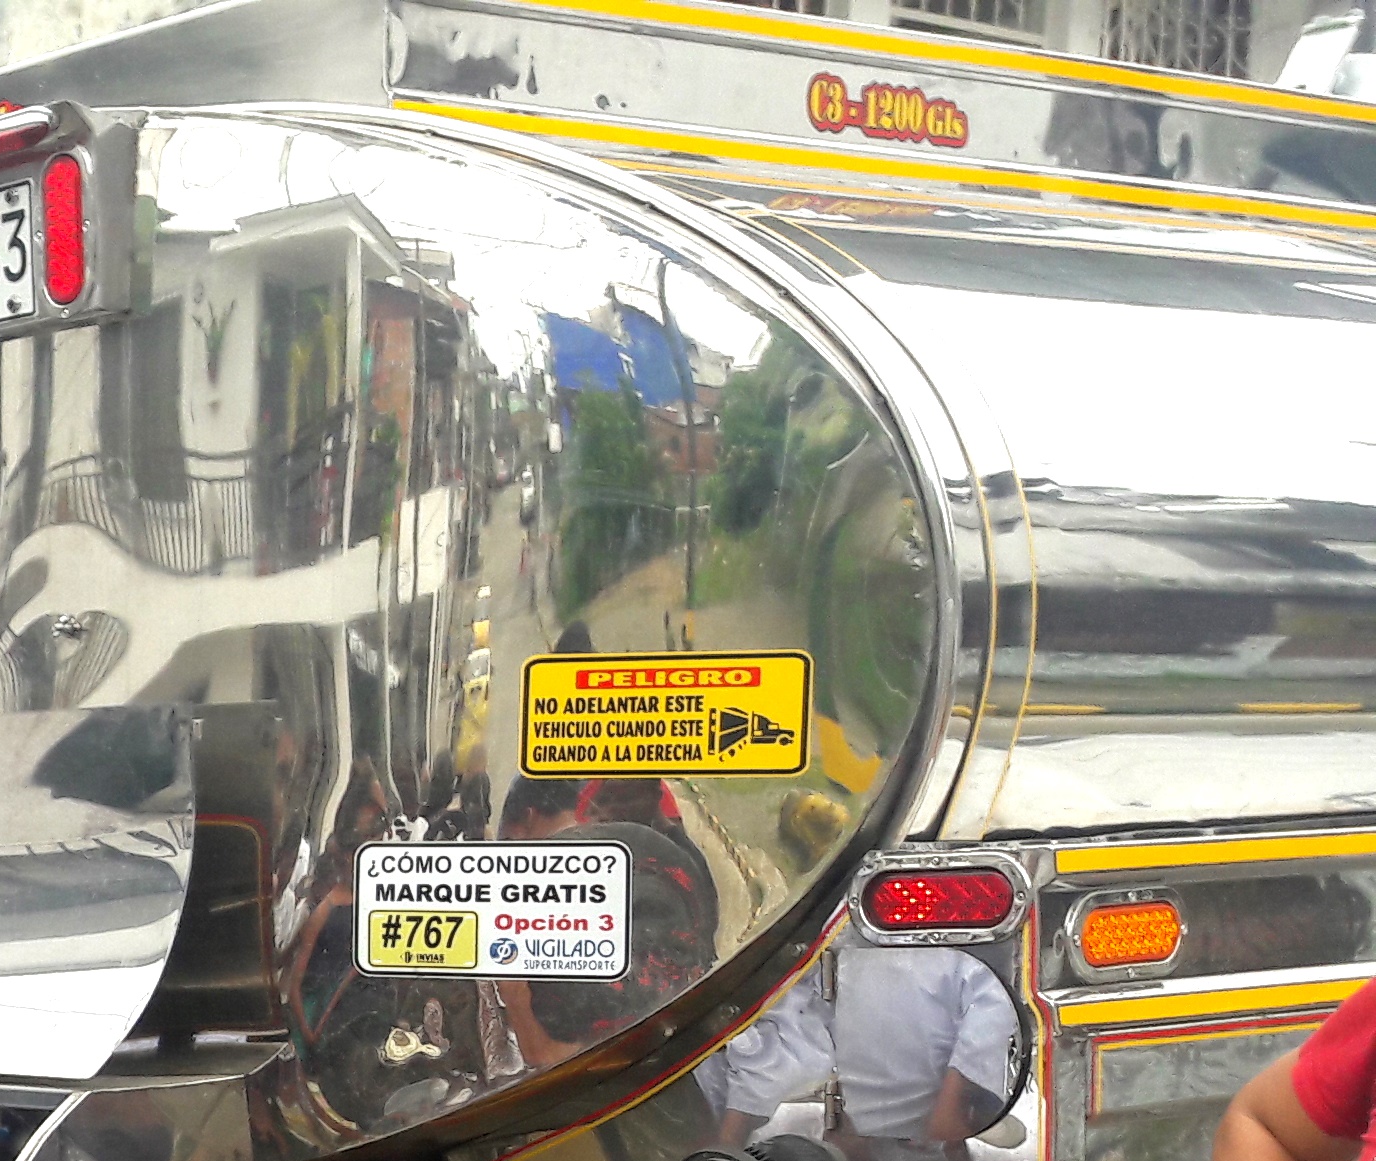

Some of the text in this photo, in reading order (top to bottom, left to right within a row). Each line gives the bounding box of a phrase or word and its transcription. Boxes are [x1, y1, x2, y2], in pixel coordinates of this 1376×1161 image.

[588, 669, 752, 687] PELIGRO
[534, 695, 705, 715] NO ADELANTAR ESTE
[533, 719, 704, 738] VEHICULO CUANDO ESTE
[533, 743, 703, 762] GIRANDO A LA DERECHA
[367, 851, 617, 878] ¿CÓMO CONDUZCO?
[375, 884, 607, 904] MARQUE GRATIS
[382, 915, 464, 949] #767
[494, 914, 615, 934] Opción 3
[524, 939, 616, 958] VIGILADO
[523, 960, 616, 971] SUPERTRANSPORTE
